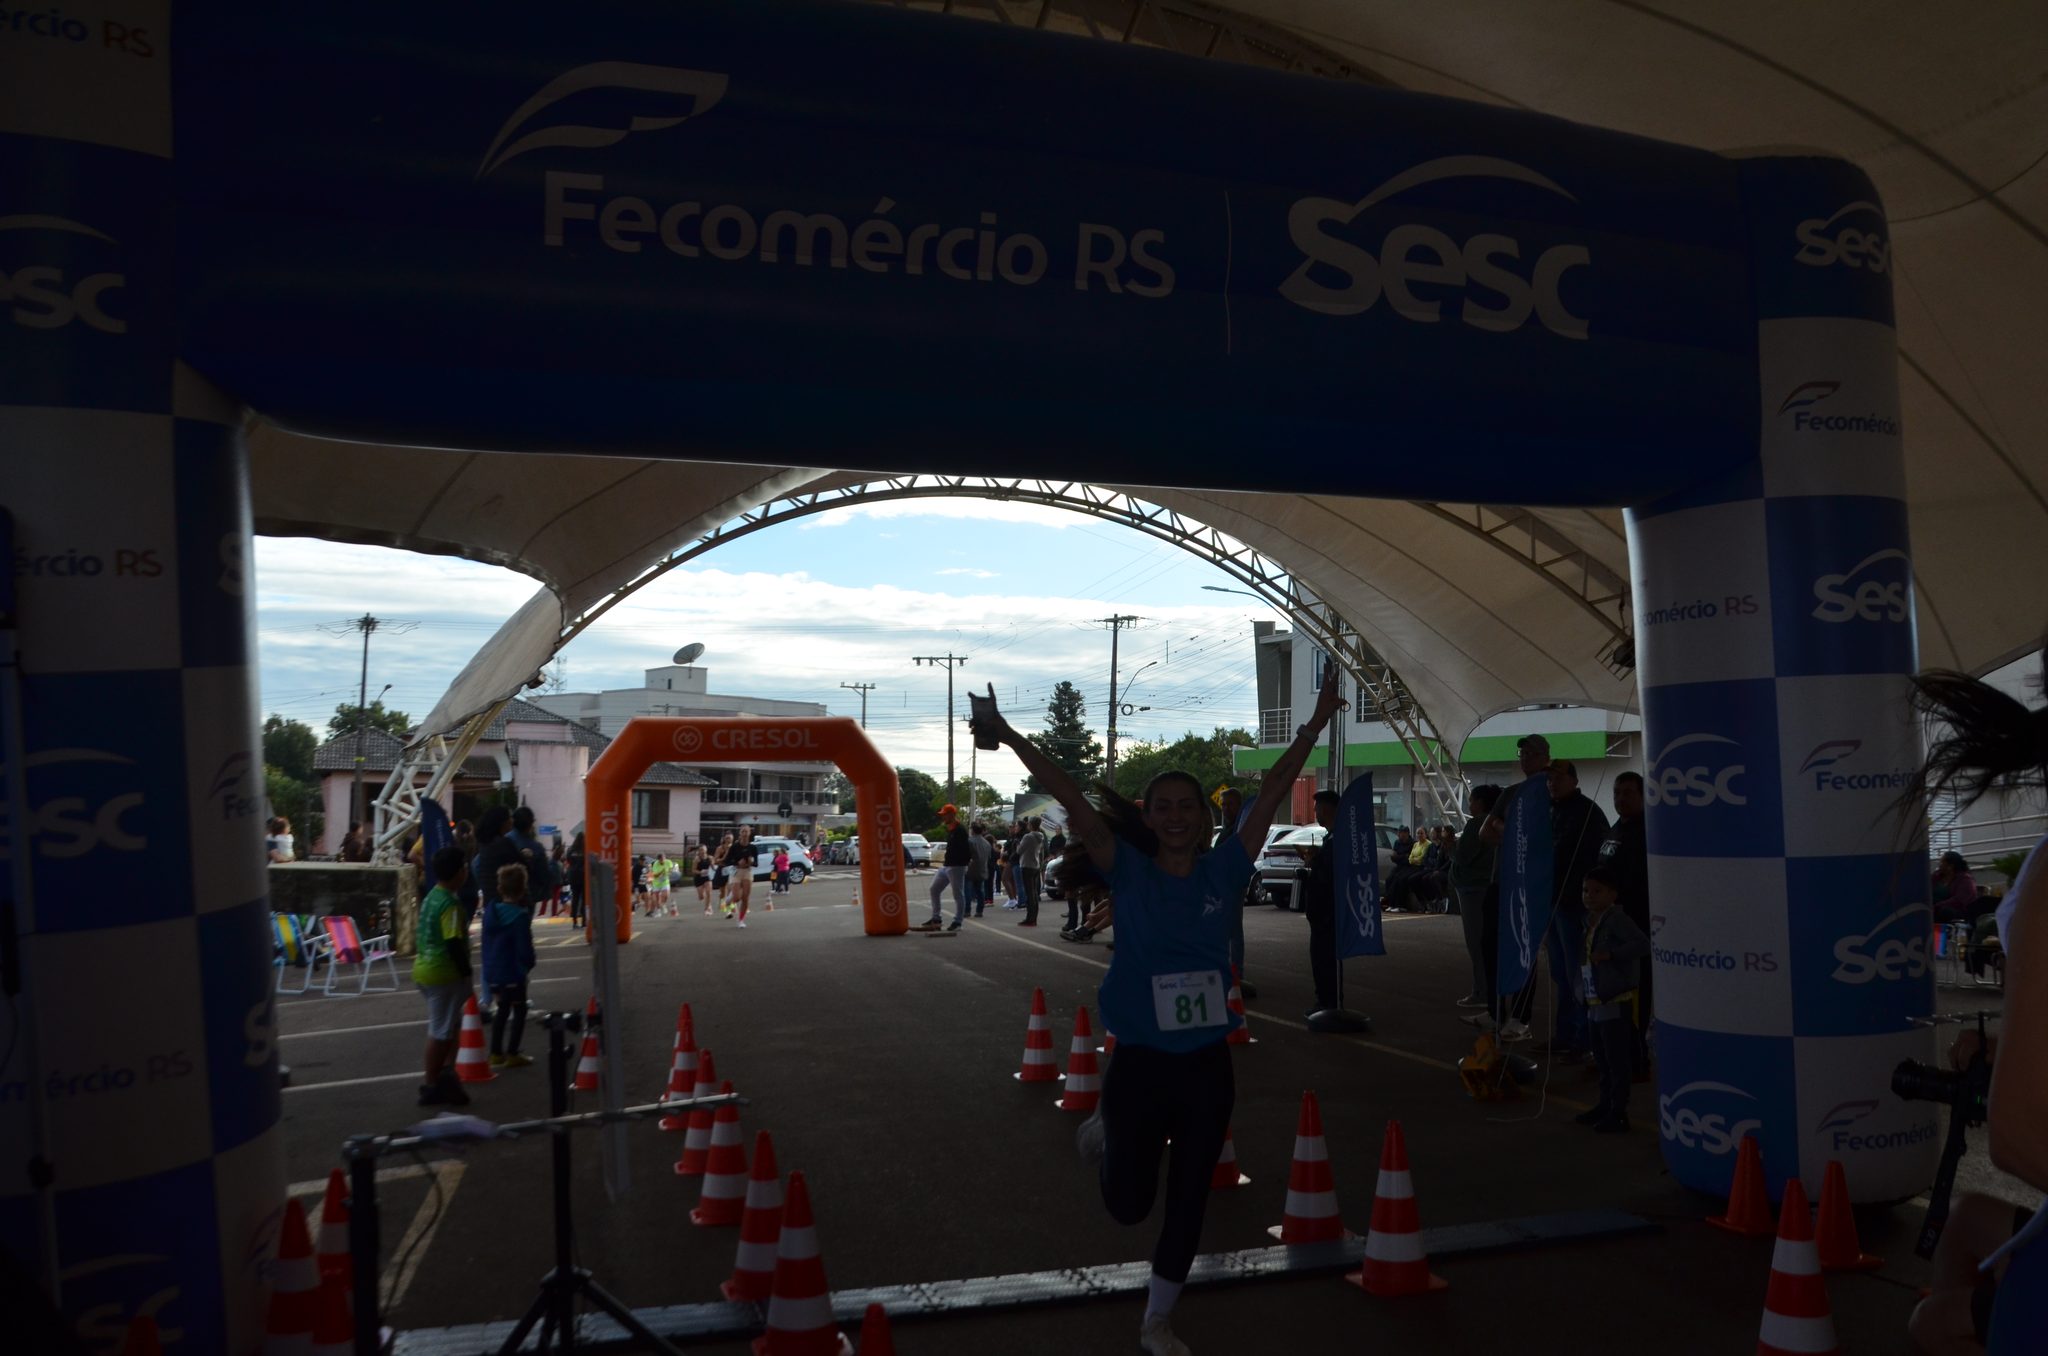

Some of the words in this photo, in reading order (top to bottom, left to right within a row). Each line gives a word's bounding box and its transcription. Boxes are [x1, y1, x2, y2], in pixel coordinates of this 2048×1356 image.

[102, 20, 154, 58] RS
[543, 169, 1049, 286] Fecomércio
[1073, 222, 1177, 299] RS
[1794, 218, 1891, 274] Ses
[1277, 196, 1591, 341] Sesc
[0, 266, 127, 334] sc
[115, 549, 163, 578] RS
[1643, 600, 1717, 627] omércio
[1725, 594, 1759, 617] RS
[1810, 574, 1909, 624] Ses
[711, 728, 819, 750] CRESOL
[601, 803, 619, 892] ESOL
[876, 797, 898, 885] CRESOL
[1357, 873, 1374, 938] Sesc
[1652, 942, 1736, 971] ecomércio
[1744, 952, 1778, 973] RS
[1175, 992, 1208, 1024] 81
[147, 1050, 193, 1084] RS
[1833, 1121, 1938, 1152] Fecomércio
